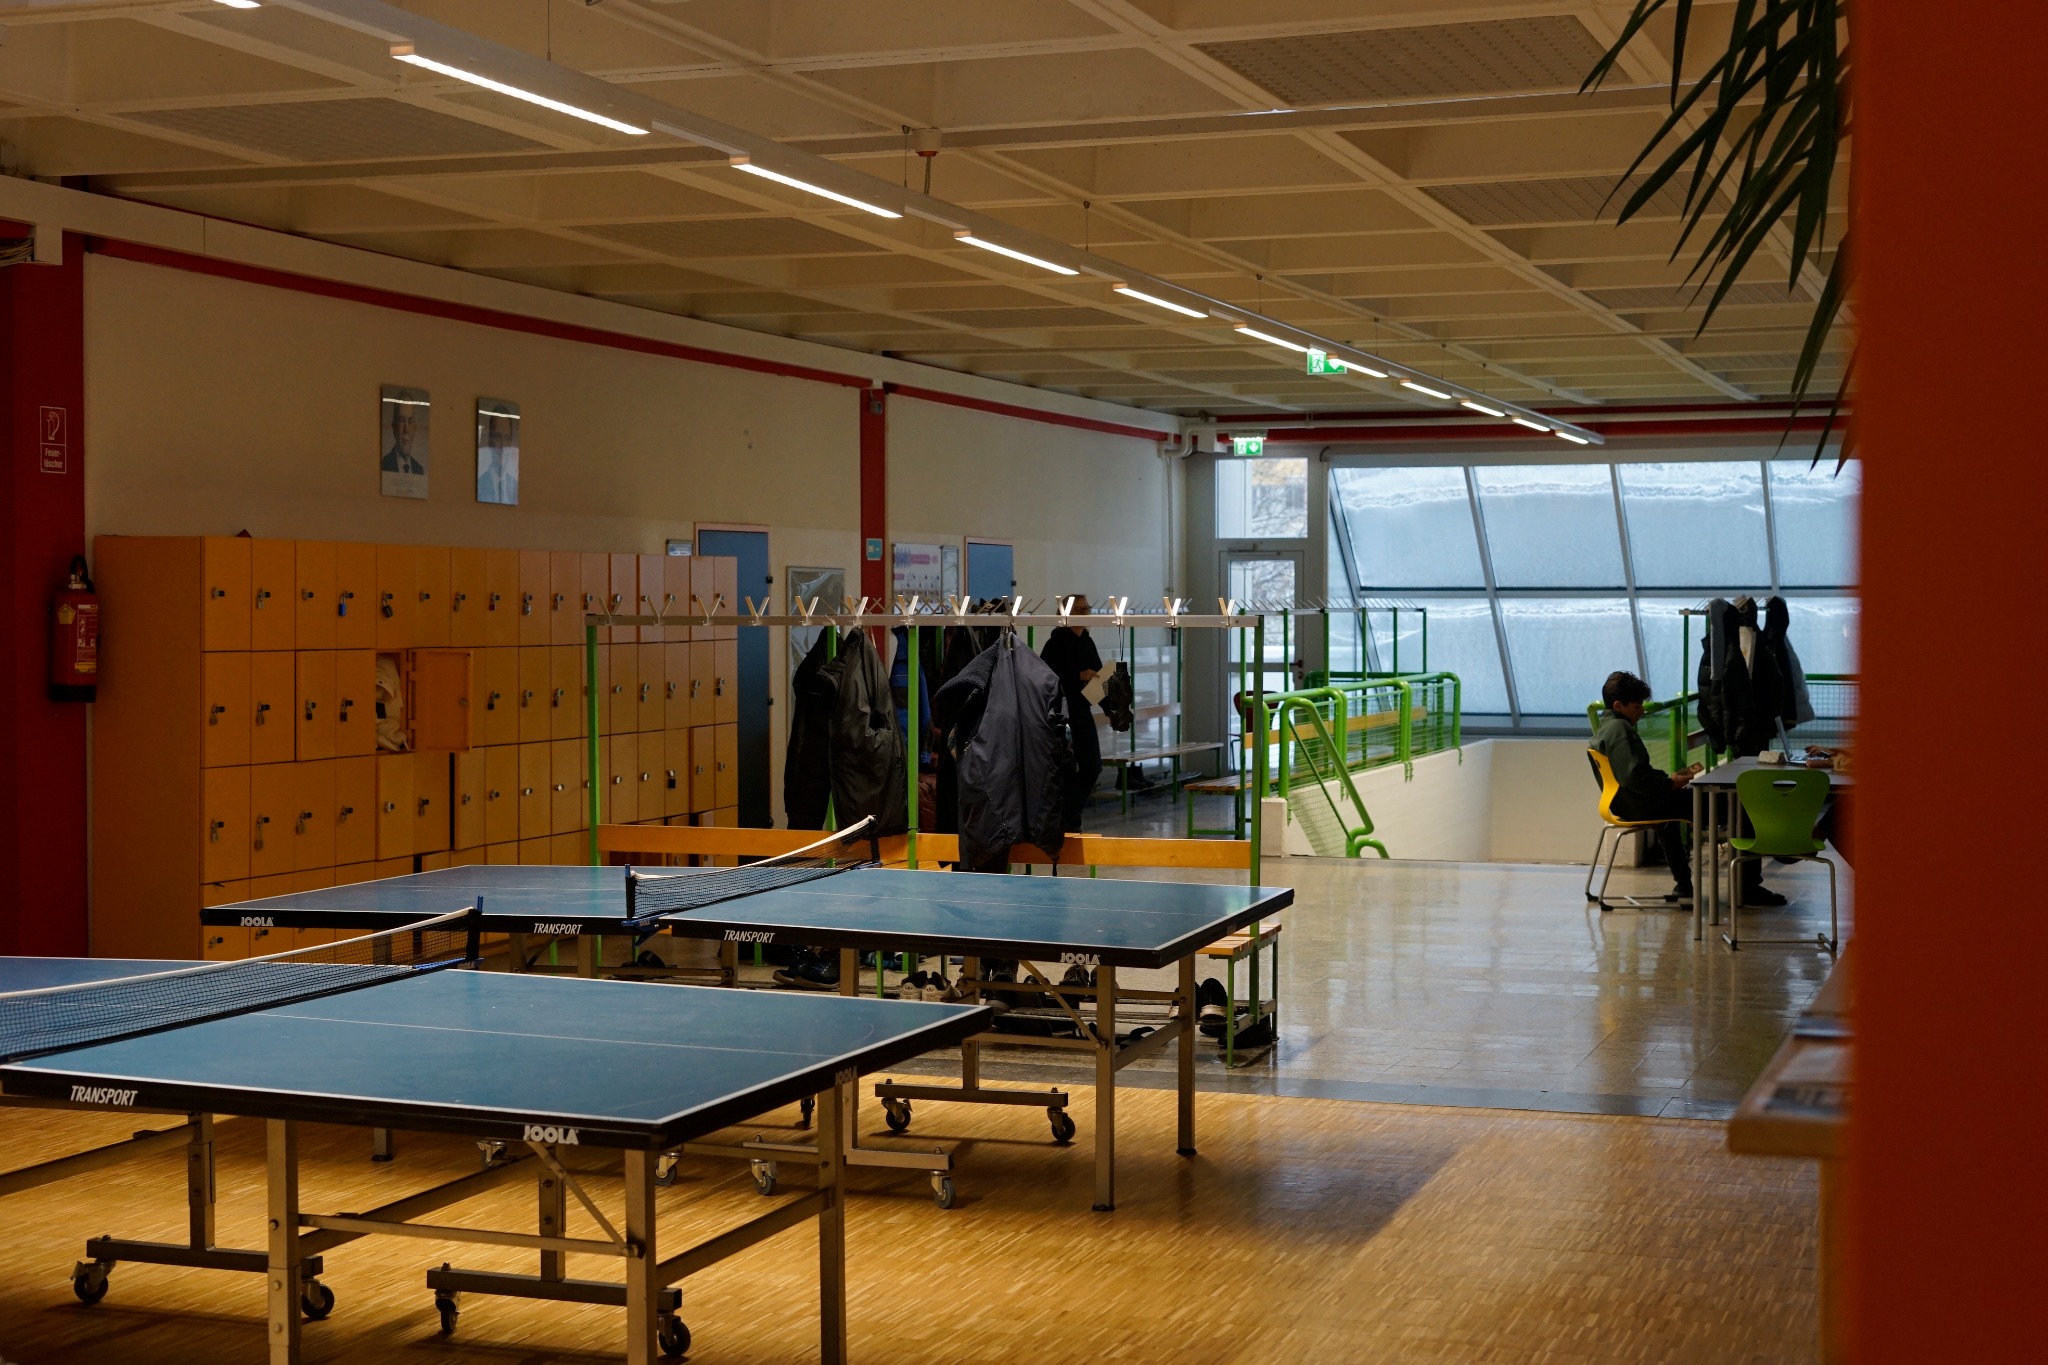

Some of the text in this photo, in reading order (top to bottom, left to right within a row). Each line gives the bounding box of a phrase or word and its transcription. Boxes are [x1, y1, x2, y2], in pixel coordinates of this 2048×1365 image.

[240, 916, 274, 927] JOOLA
[533, 922, 583, 935] TRANSPORT
[723, 929, 775, 944] TRANSPORT
[1060, 952, 1101, 965] JOOLA
[69, 1084, 139, 1107] TRANSPORT
[522, 1124, 579, 1146] JOOLA
